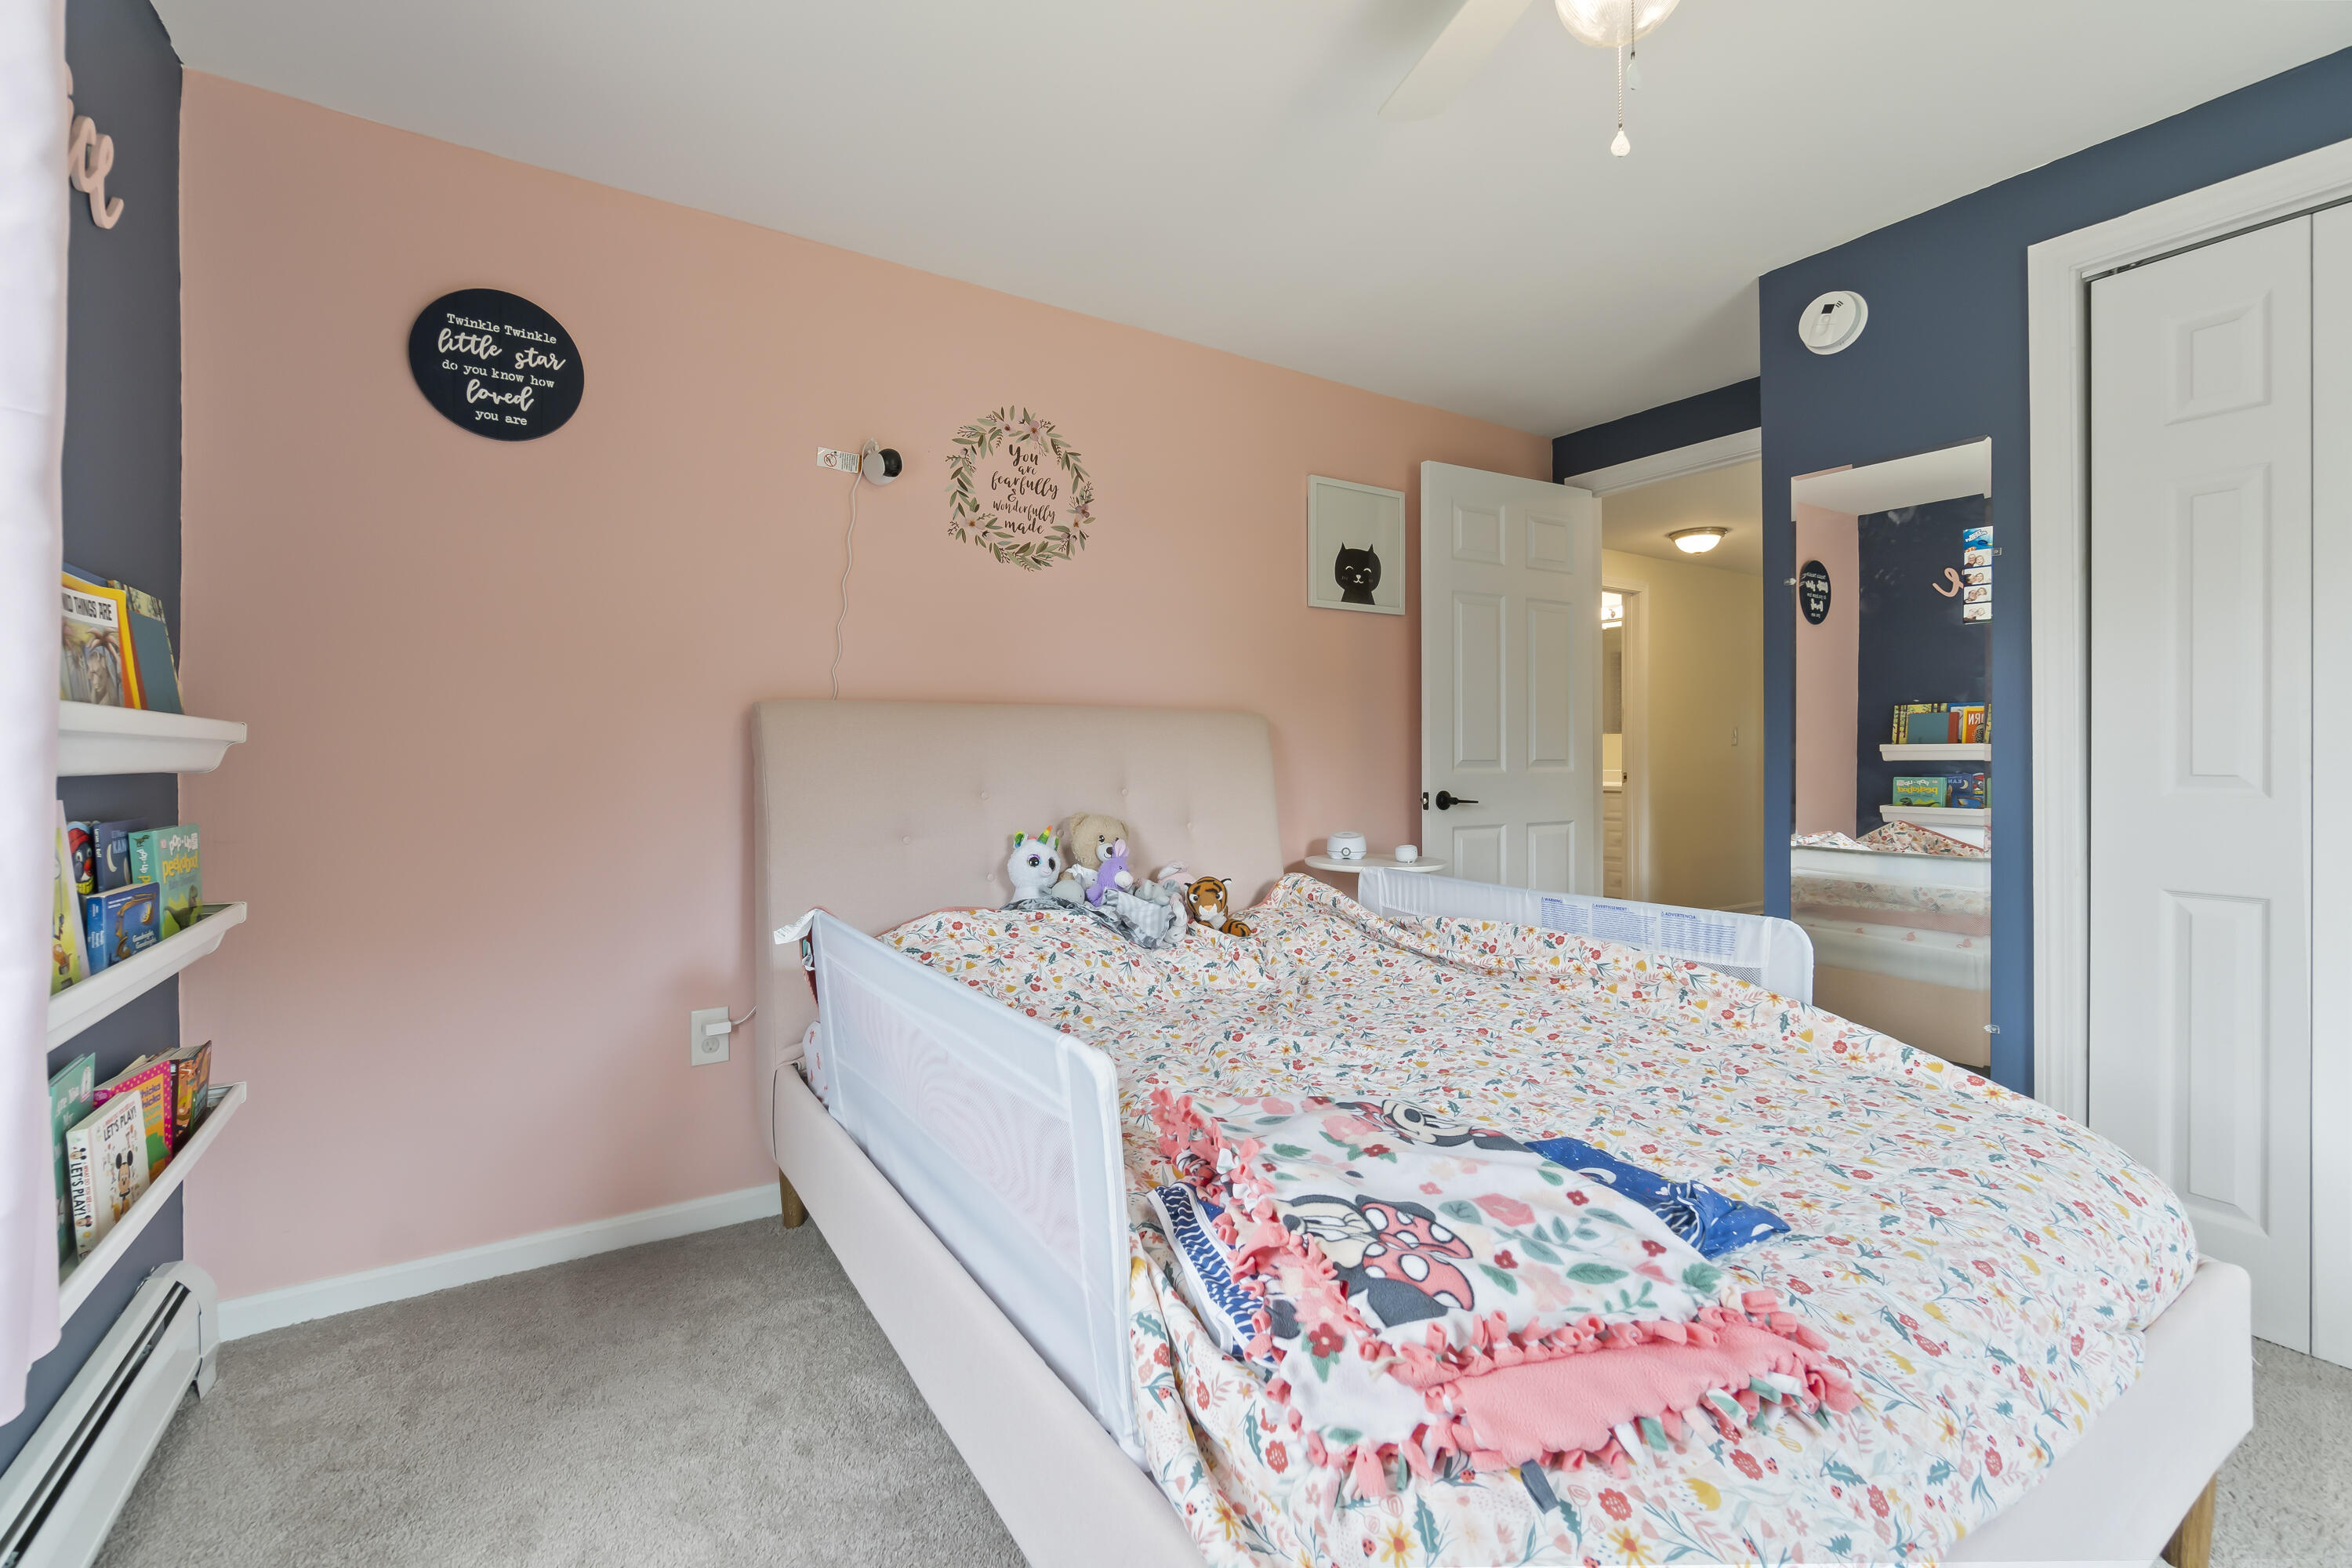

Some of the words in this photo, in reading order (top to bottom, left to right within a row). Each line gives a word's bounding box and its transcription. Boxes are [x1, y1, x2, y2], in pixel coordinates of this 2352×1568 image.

[446, 313, 500, 332] Twinkle
[504, 325, 557, 344] Twinkle
[437, 328, 503, 360] little
[514, 347, 566, 371] star
[441, 359, 458, 371] do
[463, 364, 488, 376] you
[491, 368, 524, 383] know
[530, 375, 555, 388] how
[466, 379, 535, 412] loved
[474, 409, 499, 421] you
[505, 415, 528, 426] are
[1008, 444, 1039, 466] You
[1018, 465, 1036, 475] are
[991, 470, 1059, 500] fearfully
[1007, 488, 1017, 503] &
[1004, 519, 1045, 535] made
[74, 596, 97, 619] THINGS
[98, 601, 112, 621] ARE
[104, 1120, 119, 1142] LET'S
[120, 1105, 137, 1129] PLAY!
[71, 1162, 84, 1187] LET'S
[72, 1188, 86, 1217] PLAY!
